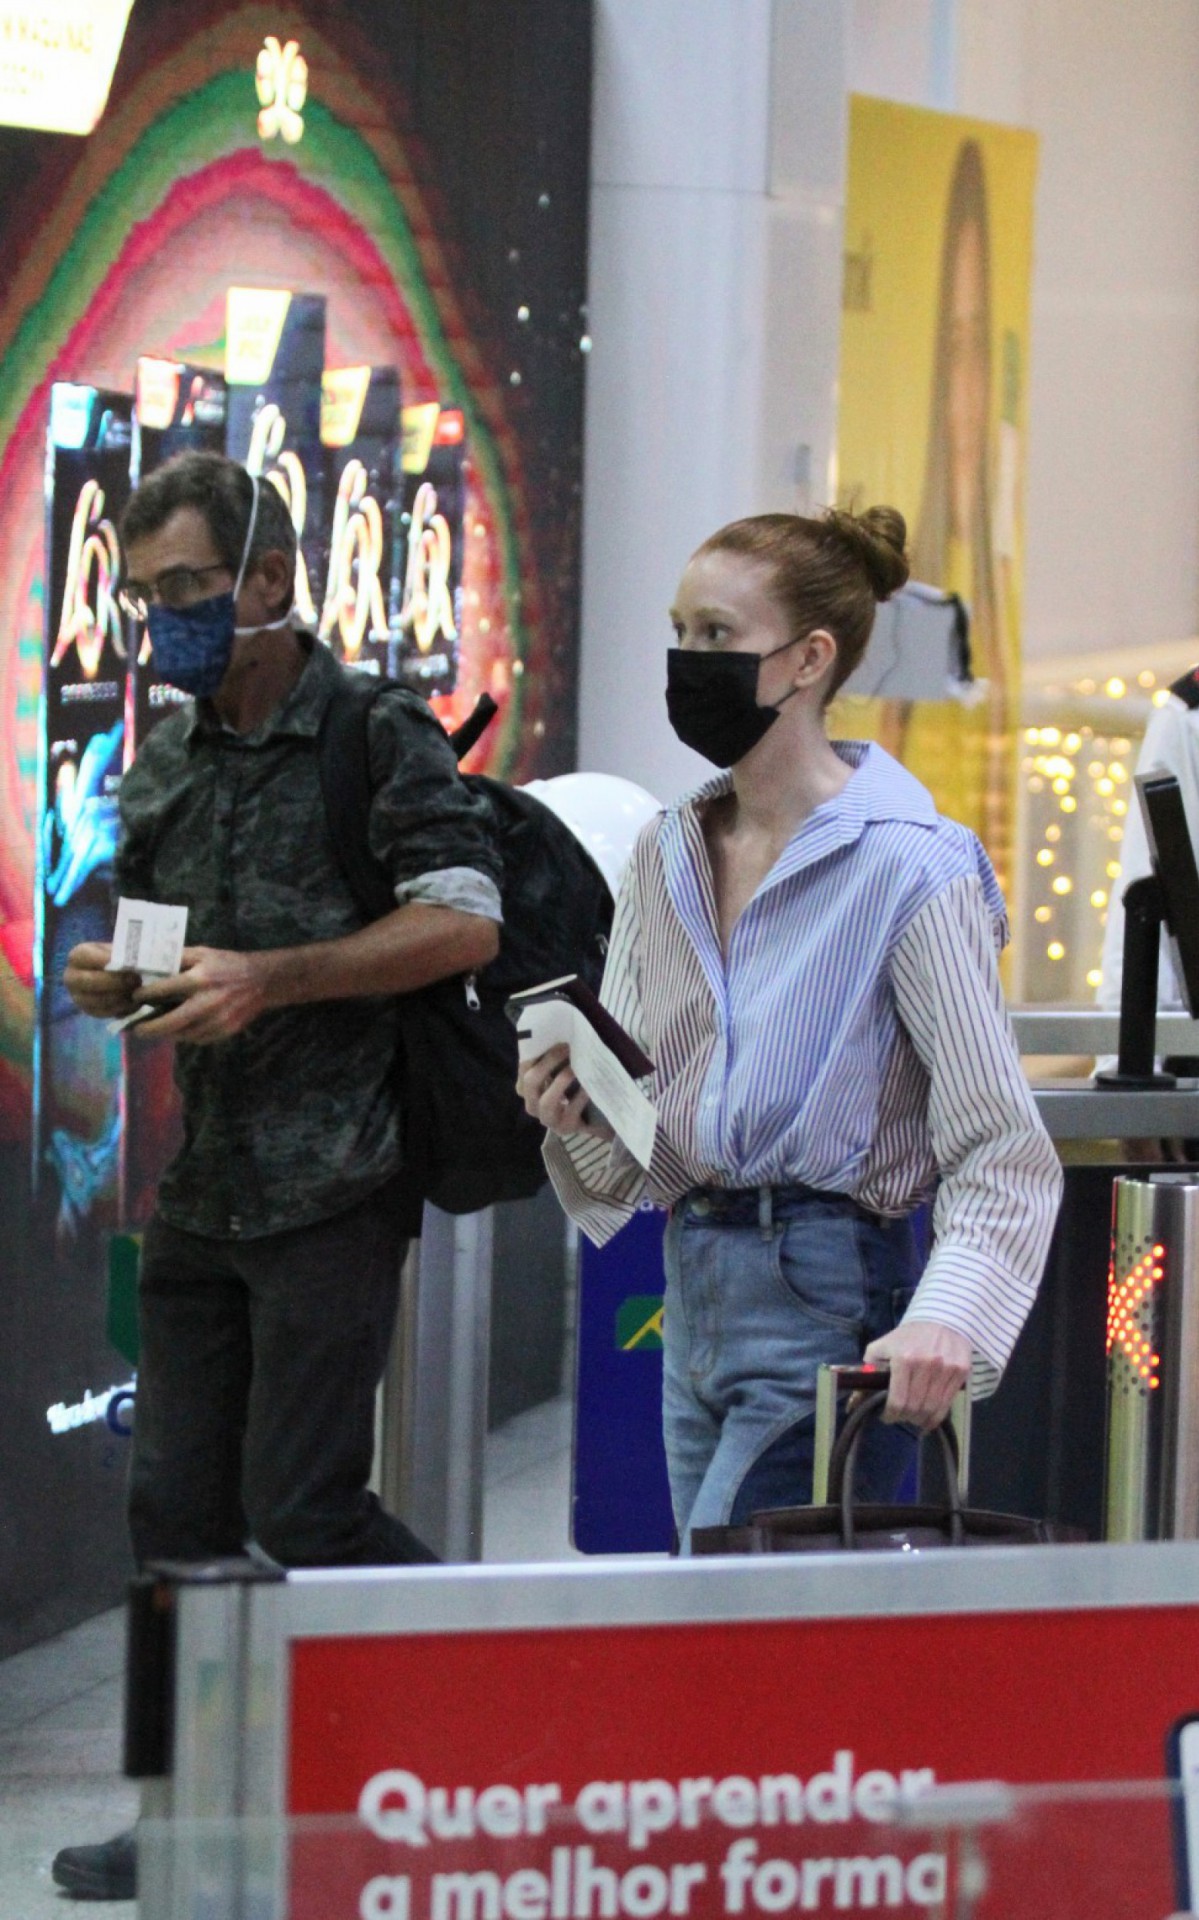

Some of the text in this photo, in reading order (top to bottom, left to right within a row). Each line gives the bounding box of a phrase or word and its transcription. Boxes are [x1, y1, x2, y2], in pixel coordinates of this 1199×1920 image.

[358, 1749, 936, 1849] Quer aprender
[359, 1837, 948, 1920] a melhor forma
